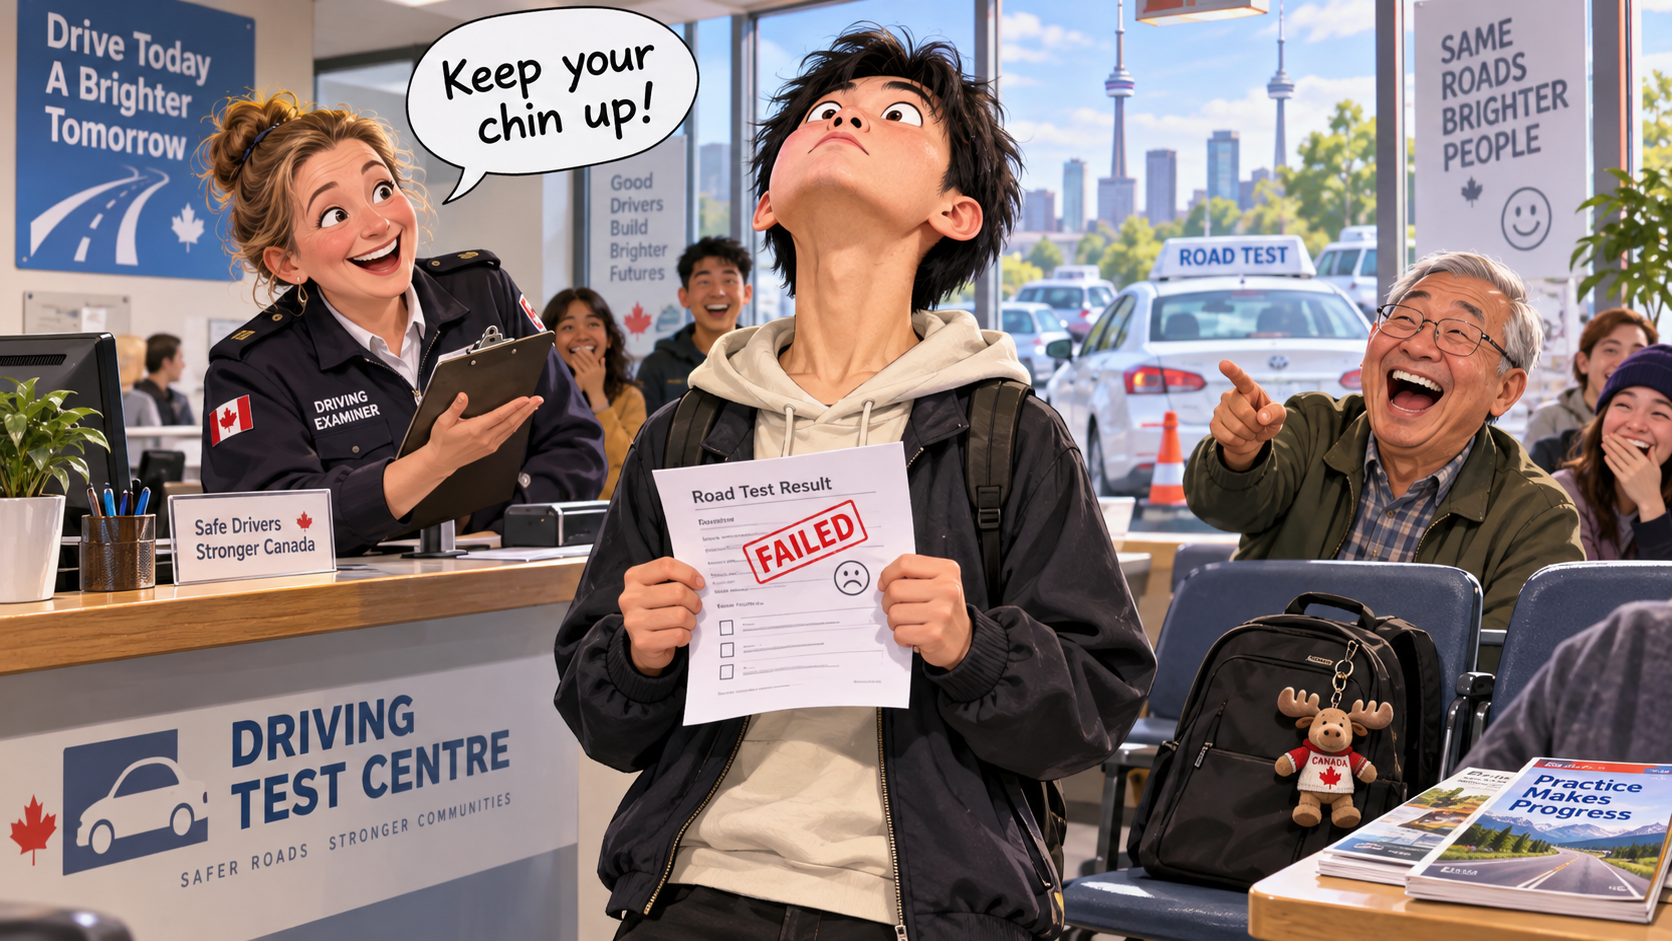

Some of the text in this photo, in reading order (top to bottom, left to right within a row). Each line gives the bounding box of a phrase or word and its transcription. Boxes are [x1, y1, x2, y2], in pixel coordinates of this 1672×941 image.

[47, 12, 211, 87] Drive Today
[1441, 17, 1513, 64] SAME
[1442, 52, 1527, 100] ROADS
[45, 60, 192, 118] A Brighter
[1442, 79, 1569, 136] BRIGHTER
[45, 105, 187, 161] Tomorrow
[1444, 123, 1541, 172] PEOPLE
[610, 172, 653, 191] Good
[610, 197, 664, 214] Drivers
[610, 218, 648, 236] Build
[610, 242, 668, 262] Brighter
[1179, 246, 1288, 266] ROAD TEST
[610, 265, 665, 282] Futures
[314, 390, 368, 413] DRIVING
[314, 404, 380, 430] EXAMINER
[692, 476, 833, 504] Road Test Result
[195, 516, 282, 536] Safe Drivers
[196, 536, 315, 561] Stronger Canada
[755, 513, 855, 573] FAILED
[232, 694, 414, 768] DRIVING
[1312, 756, 1348, 768] CANADA
[231, 729, 510, 830] TEST CENTRE
[1533, 774, 1643, 793] Practice
[1522, 787, 1612, 805] Makes
[1508, 799, 1632, 821] Progress
[181, 792, 511, 888] SAFER ROADS STRONGER COMMUNITIES
